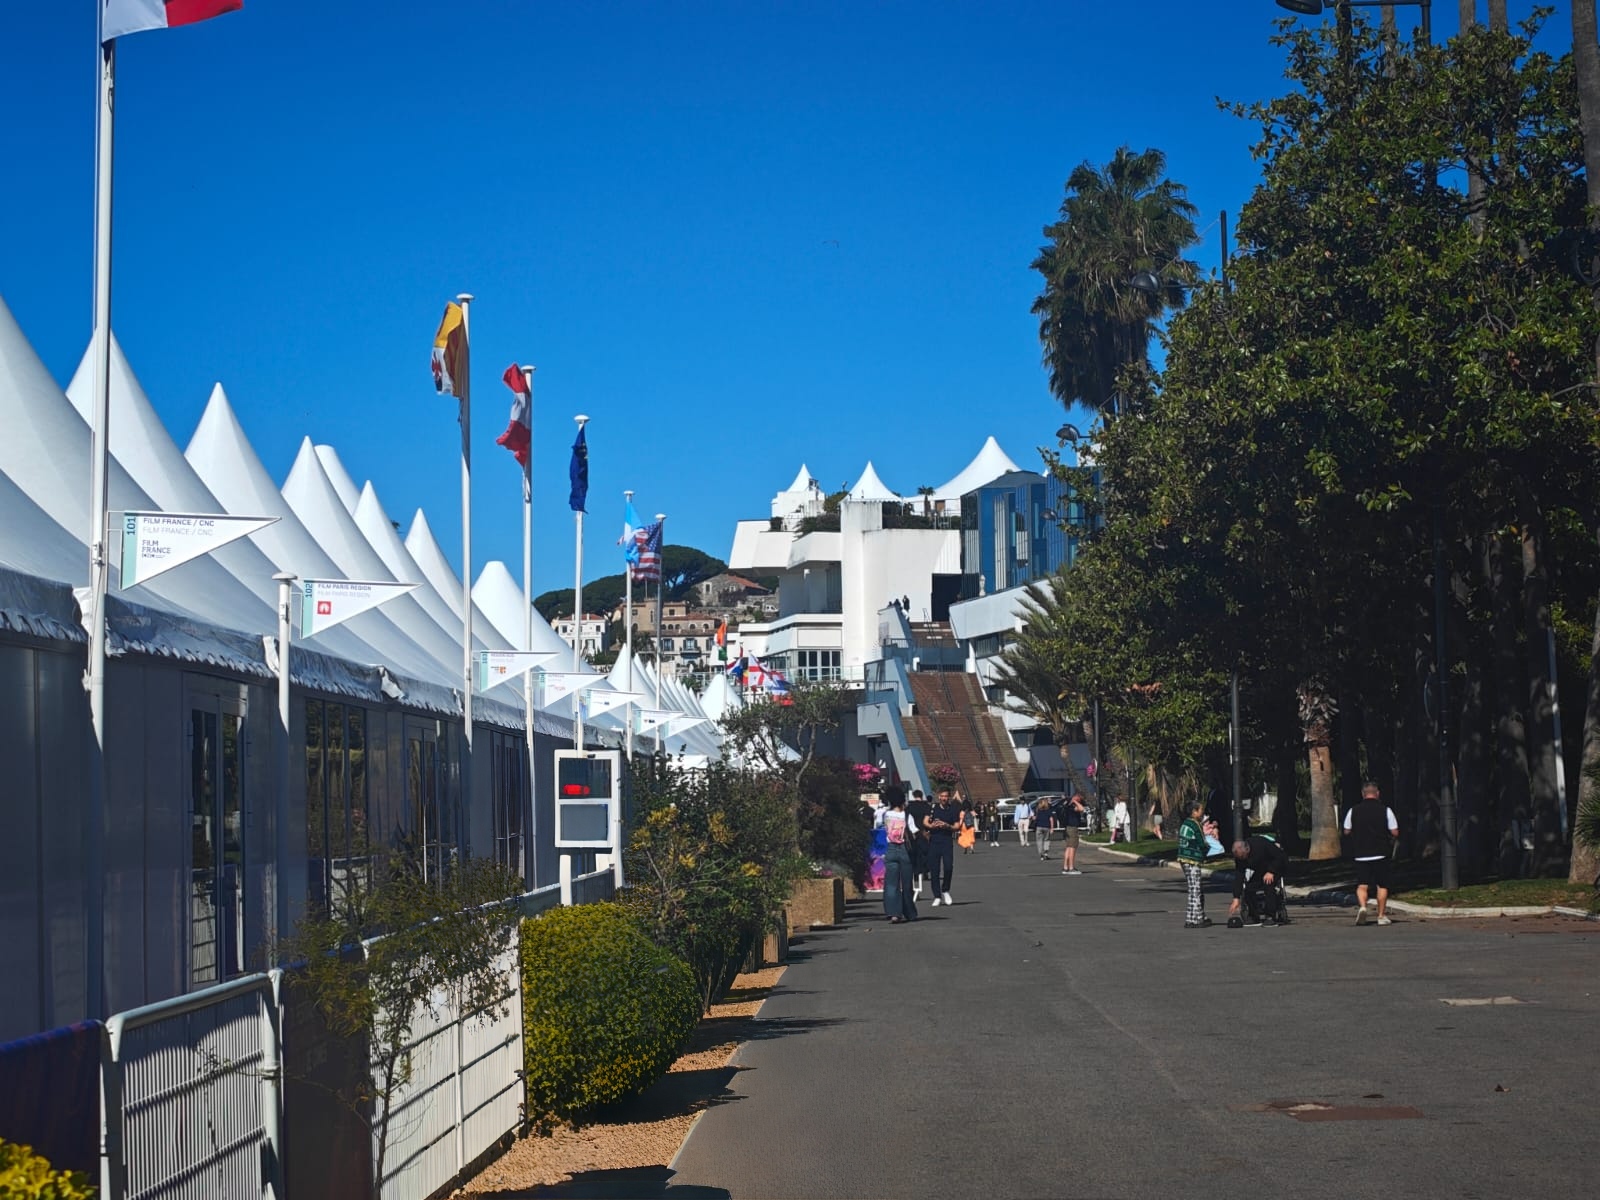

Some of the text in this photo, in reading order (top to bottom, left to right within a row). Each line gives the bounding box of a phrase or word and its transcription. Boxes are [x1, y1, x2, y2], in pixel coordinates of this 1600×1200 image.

[126, 517, 136, 535] 101
[162, 518, 192, 526] FRANCE
[161, 527, 192, 535] FRANCE
[197, 528, 213, 536] CNC
[305, 583, 313, 598] 102
